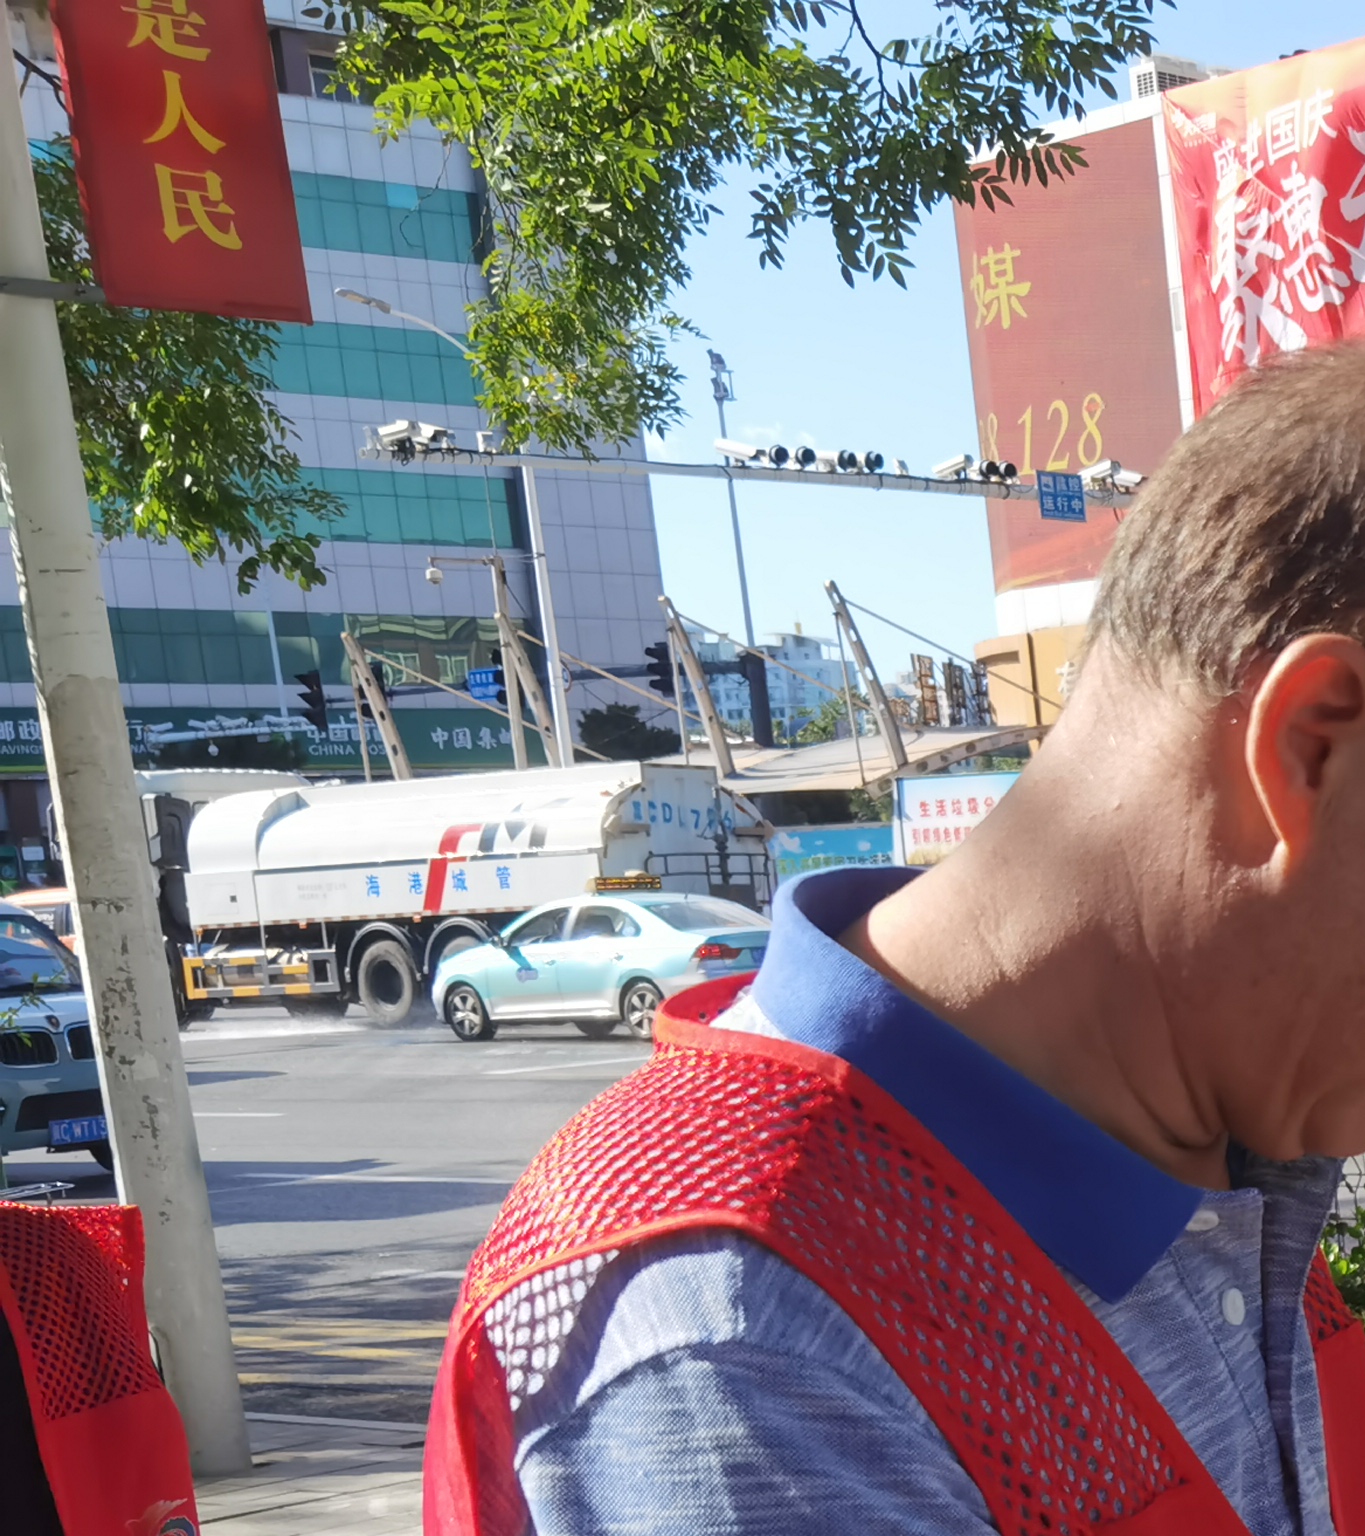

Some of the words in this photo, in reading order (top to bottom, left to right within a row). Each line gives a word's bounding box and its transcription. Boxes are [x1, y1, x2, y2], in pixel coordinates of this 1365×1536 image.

[1212, 88, 1338, 199] 盛世国庆
[970, 242, 1031, 329] 媒
[308, 744, 355, 756] CHINA
